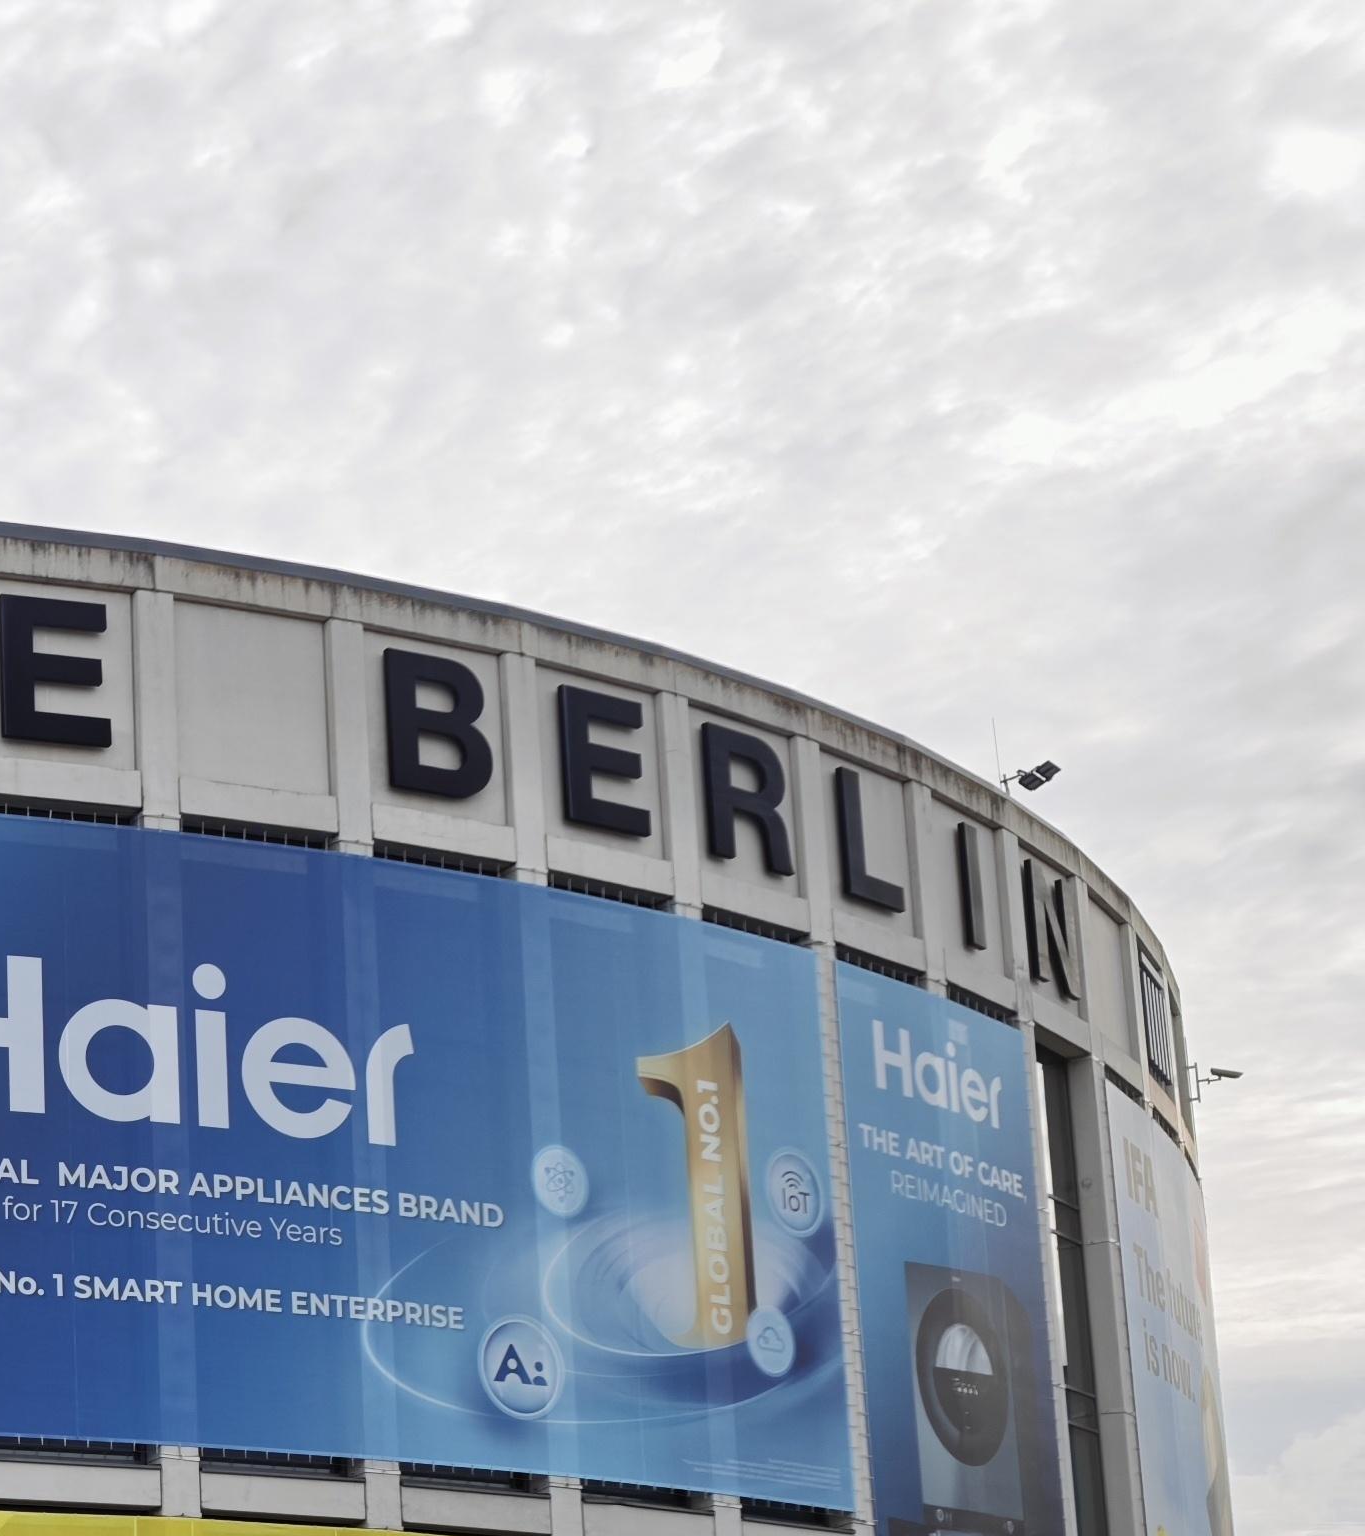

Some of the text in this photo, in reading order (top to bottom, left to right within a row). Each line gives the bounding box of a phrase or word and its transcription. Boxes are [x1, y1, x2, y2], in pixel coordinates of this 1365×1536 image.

[383, 647, 1081, 1000] BERLIN
[872, 1019, 1002, 1129] Haier
[57, 1161, 179, 1195] MAJOR
[189, 1172, 389, 1216] APPLIANCES
[398, 1193, 504, 1228] BRAND
[858, 1123, 1027, 1204] THE ART OF CARE,
[891, 1169, 1007, 1227] REIMAGINED
[1123, 1136, 1159, 1218] IFA
[2, 1195, 343, 1246] for 17 Consecutive Years
[696, 1079, 733, 1335] GLOBAL NO.1
[781, 1188, 810, 1214] IoT
[52, 1273, 64, 1298] 1
[74, 1275, 182, 1306] SMART
[191, 1283, 282, 1313] HOME
[291, 1292, 465, 1330] ENTERPRISE
